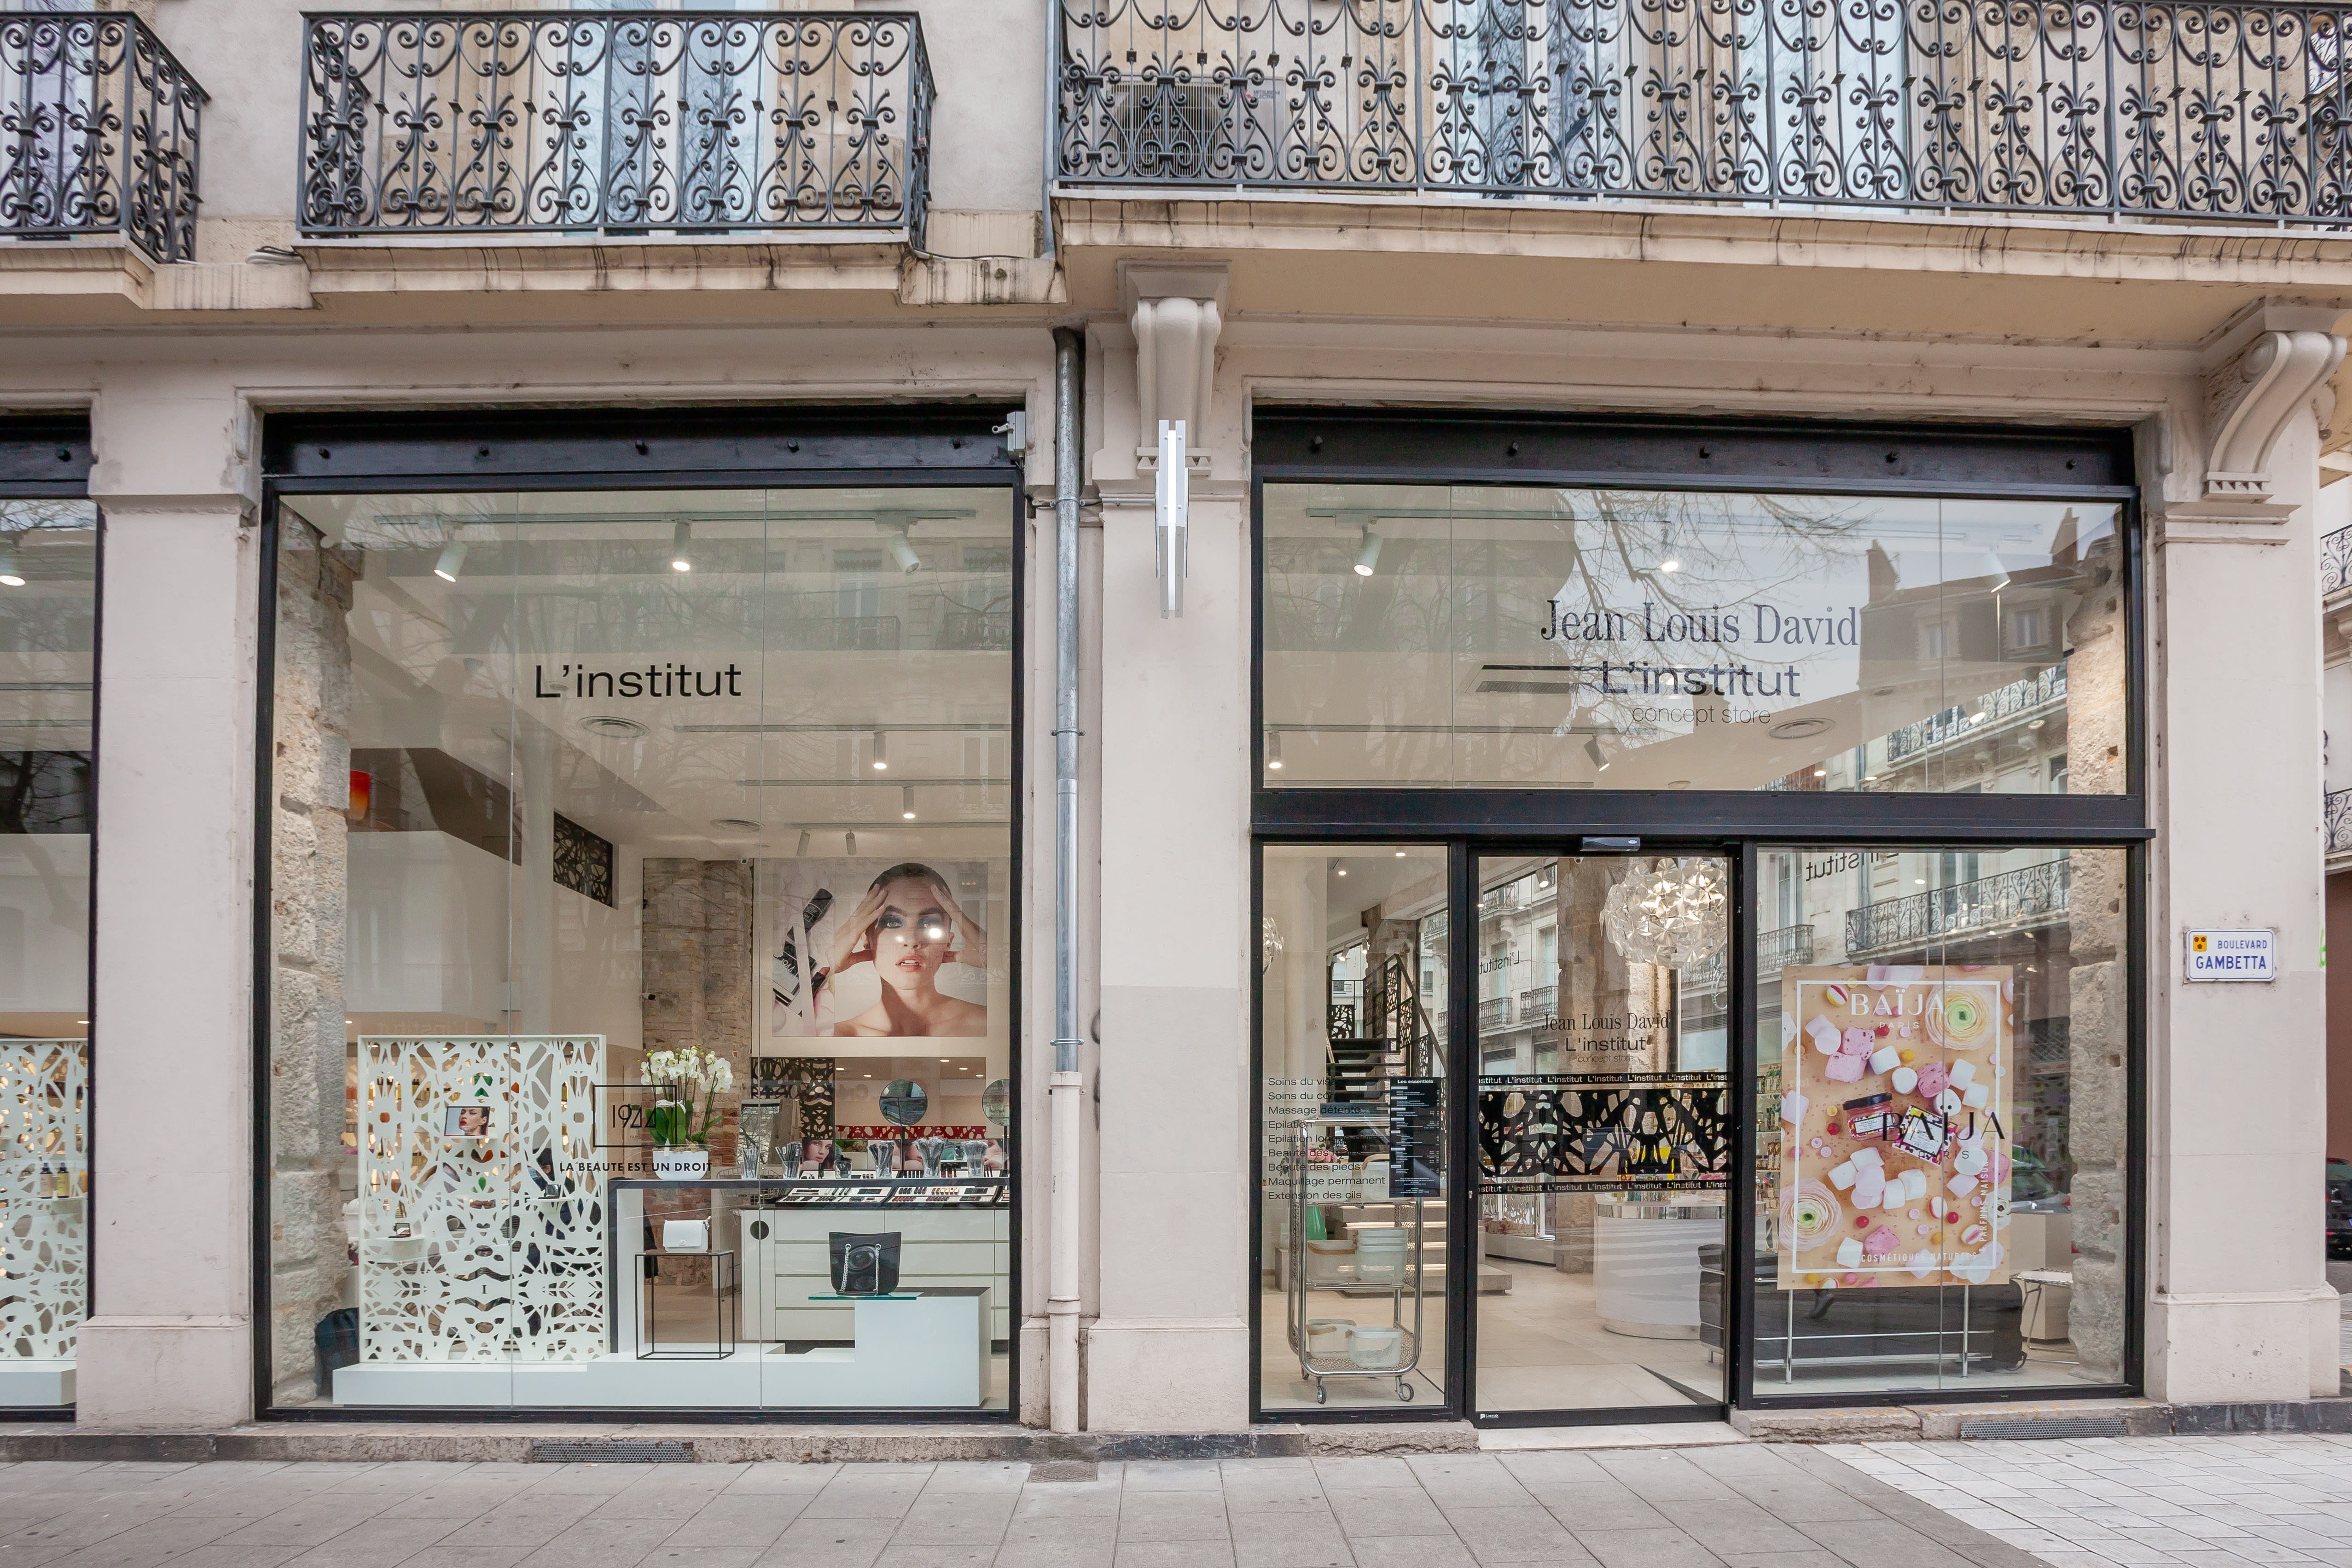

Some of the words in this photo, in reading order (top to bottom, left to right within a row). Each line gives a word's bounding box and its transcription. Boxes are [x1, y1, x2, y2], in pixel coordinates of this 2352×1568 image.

[1540, 600, 1626, 641] Jean
[1643, 602, 1740, 644] Louis
[1754, 604, 1859, 645] David
[535, 662, 742, 698] L'institut
[1603, 660, 1800, 697] L'institut
[1632, 703, 1715, 726] concept
[1722, 705, 1771, 724] store
[2218, 940, 2267, 949] BOULEVARD
[2196, 956, 2266, 969] GAMBETTA
[1852, 989, 1946, 1016] BAÏJA
[1542, 1014, 1576, 1031] Jean
[1582, 1013, 1621, 1030] Louis
[1627, 1012, 1669, 1029] David
[1565, 1037, 1646, 1052] L'institut
[1578, 1055, 1612, 1064] concept
[1614, 1054, 1634, 1063] store
[1269, 1106, 1317, 1115] Massage
[1321, 1105, 1360, 1114] détente
[1269, 1120, 1312, 1128] Epilation
[1269, 1135, 1312, 1144] Epilation
[559, 1162, 575, 1172] LA
[579, 1162, 624, 1172] BEAUTE
[627, 1162, 648, 1172] EST
[652, 1162, 670, 1172] UN
[674, 1162, 713, 1172] DROIT
[1332, 1162, 1360, 1172] pieds
[1269, 1177, 1324, 1186] Maquillage
[1328, 1176, 1385, 1186] permanent
[1269, 1191, 1319, 1200] Extension
[1979, 1201, 1988, 1242] PARFUMS
